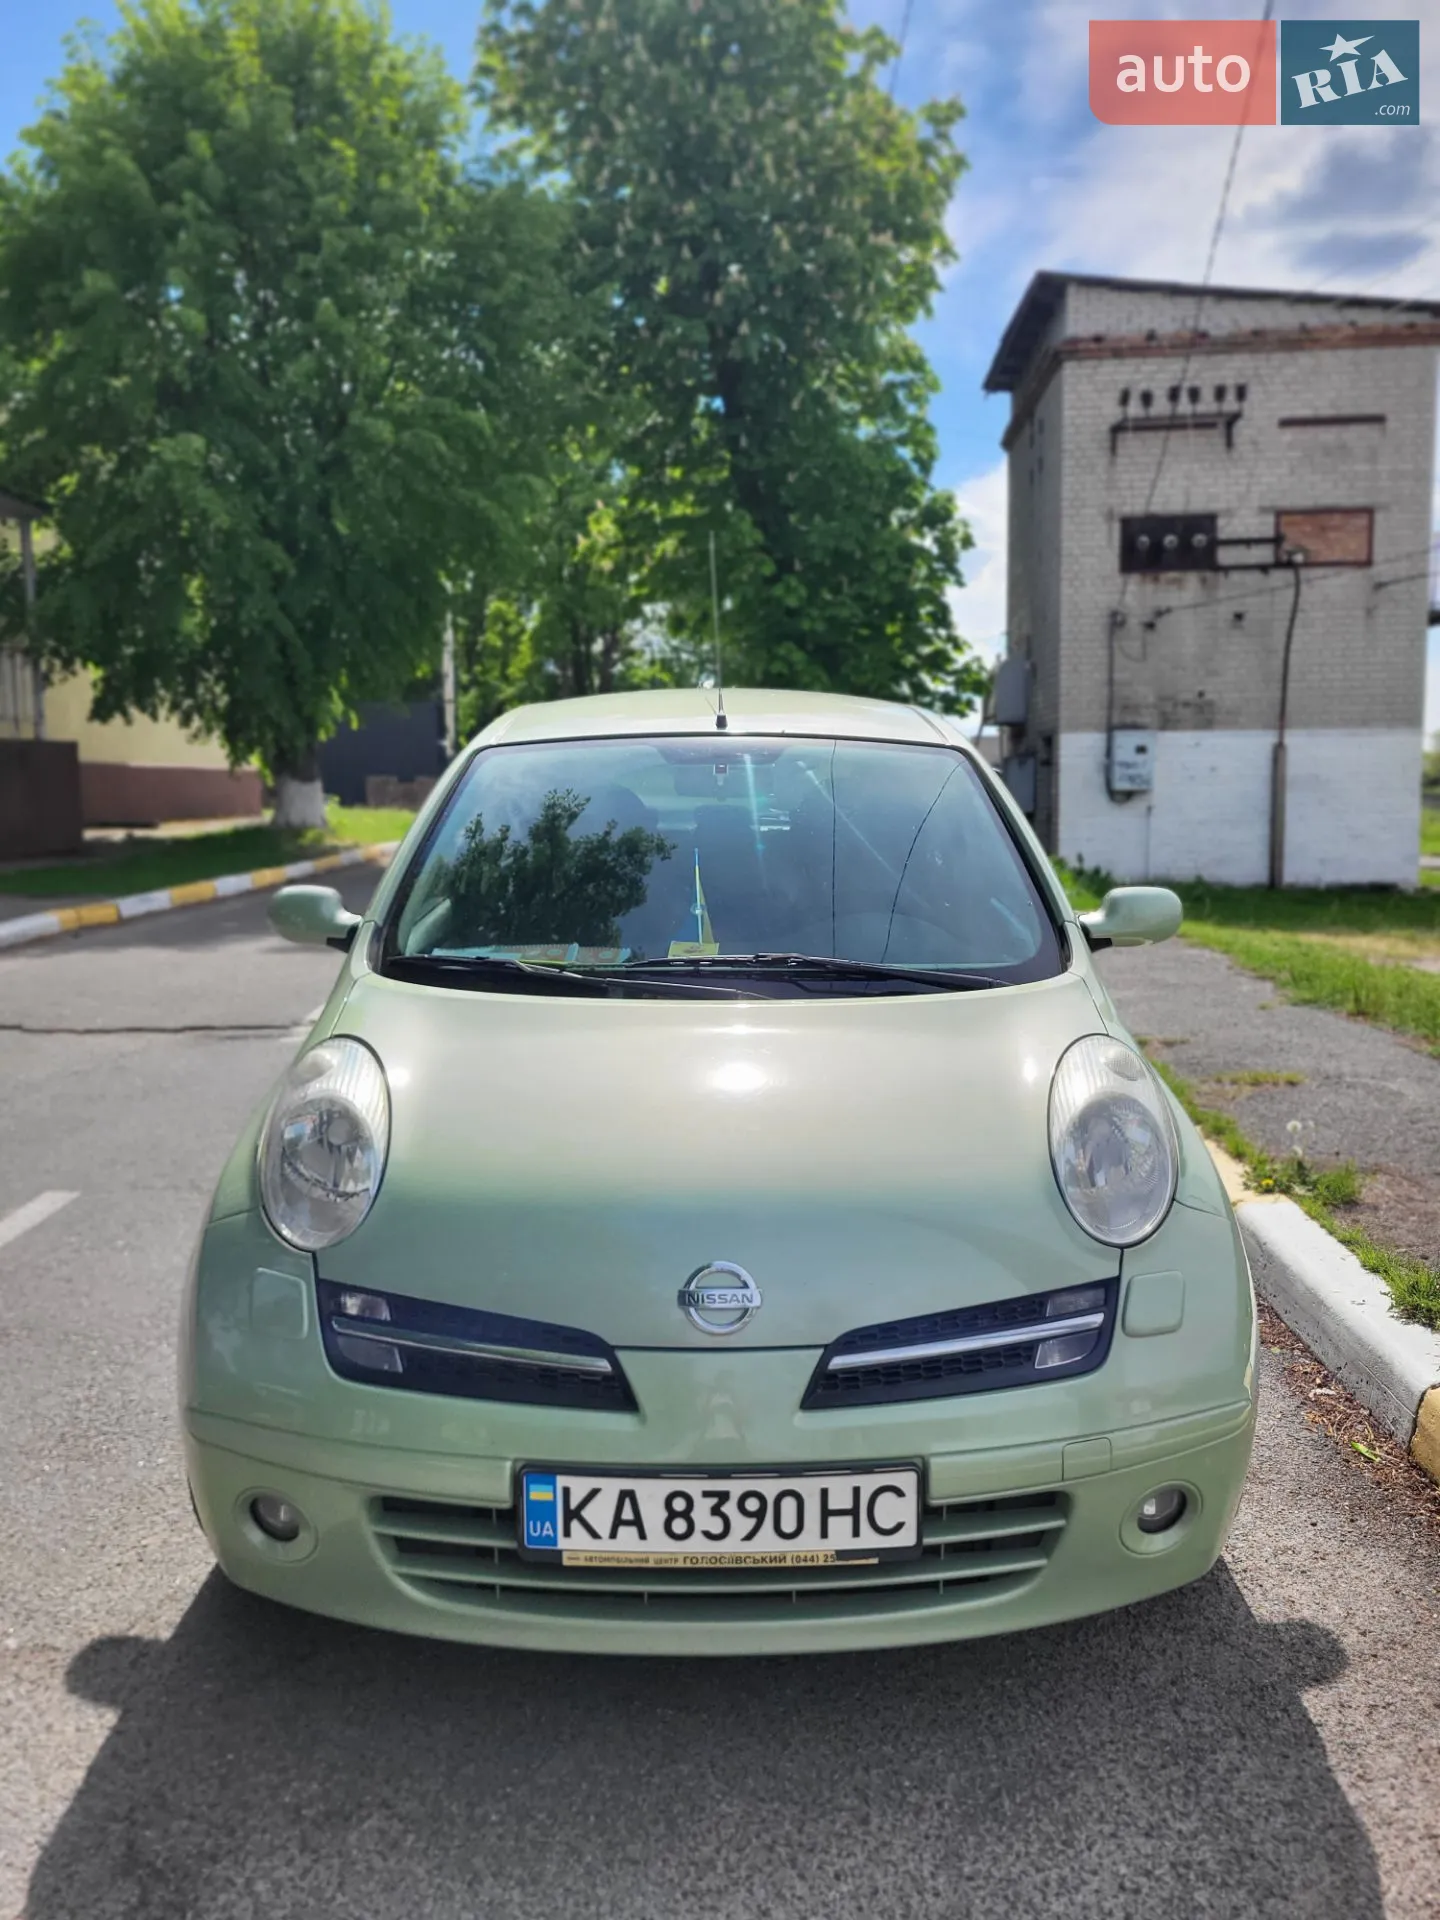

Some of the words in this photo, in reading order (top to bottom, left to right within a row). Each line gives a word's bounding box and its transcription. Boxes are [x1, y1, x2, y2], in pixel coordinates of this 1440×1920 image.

[685, 1293, 754, 1305] NISSAN
[561, 1485, 648, 1541] KA
[663, 1489, 806, 1542] 8390
[819, 1484, 907, 1539] HC
[529, 1519, 554, 1538] UA
[790, 1553, 819, 1565] (044)
